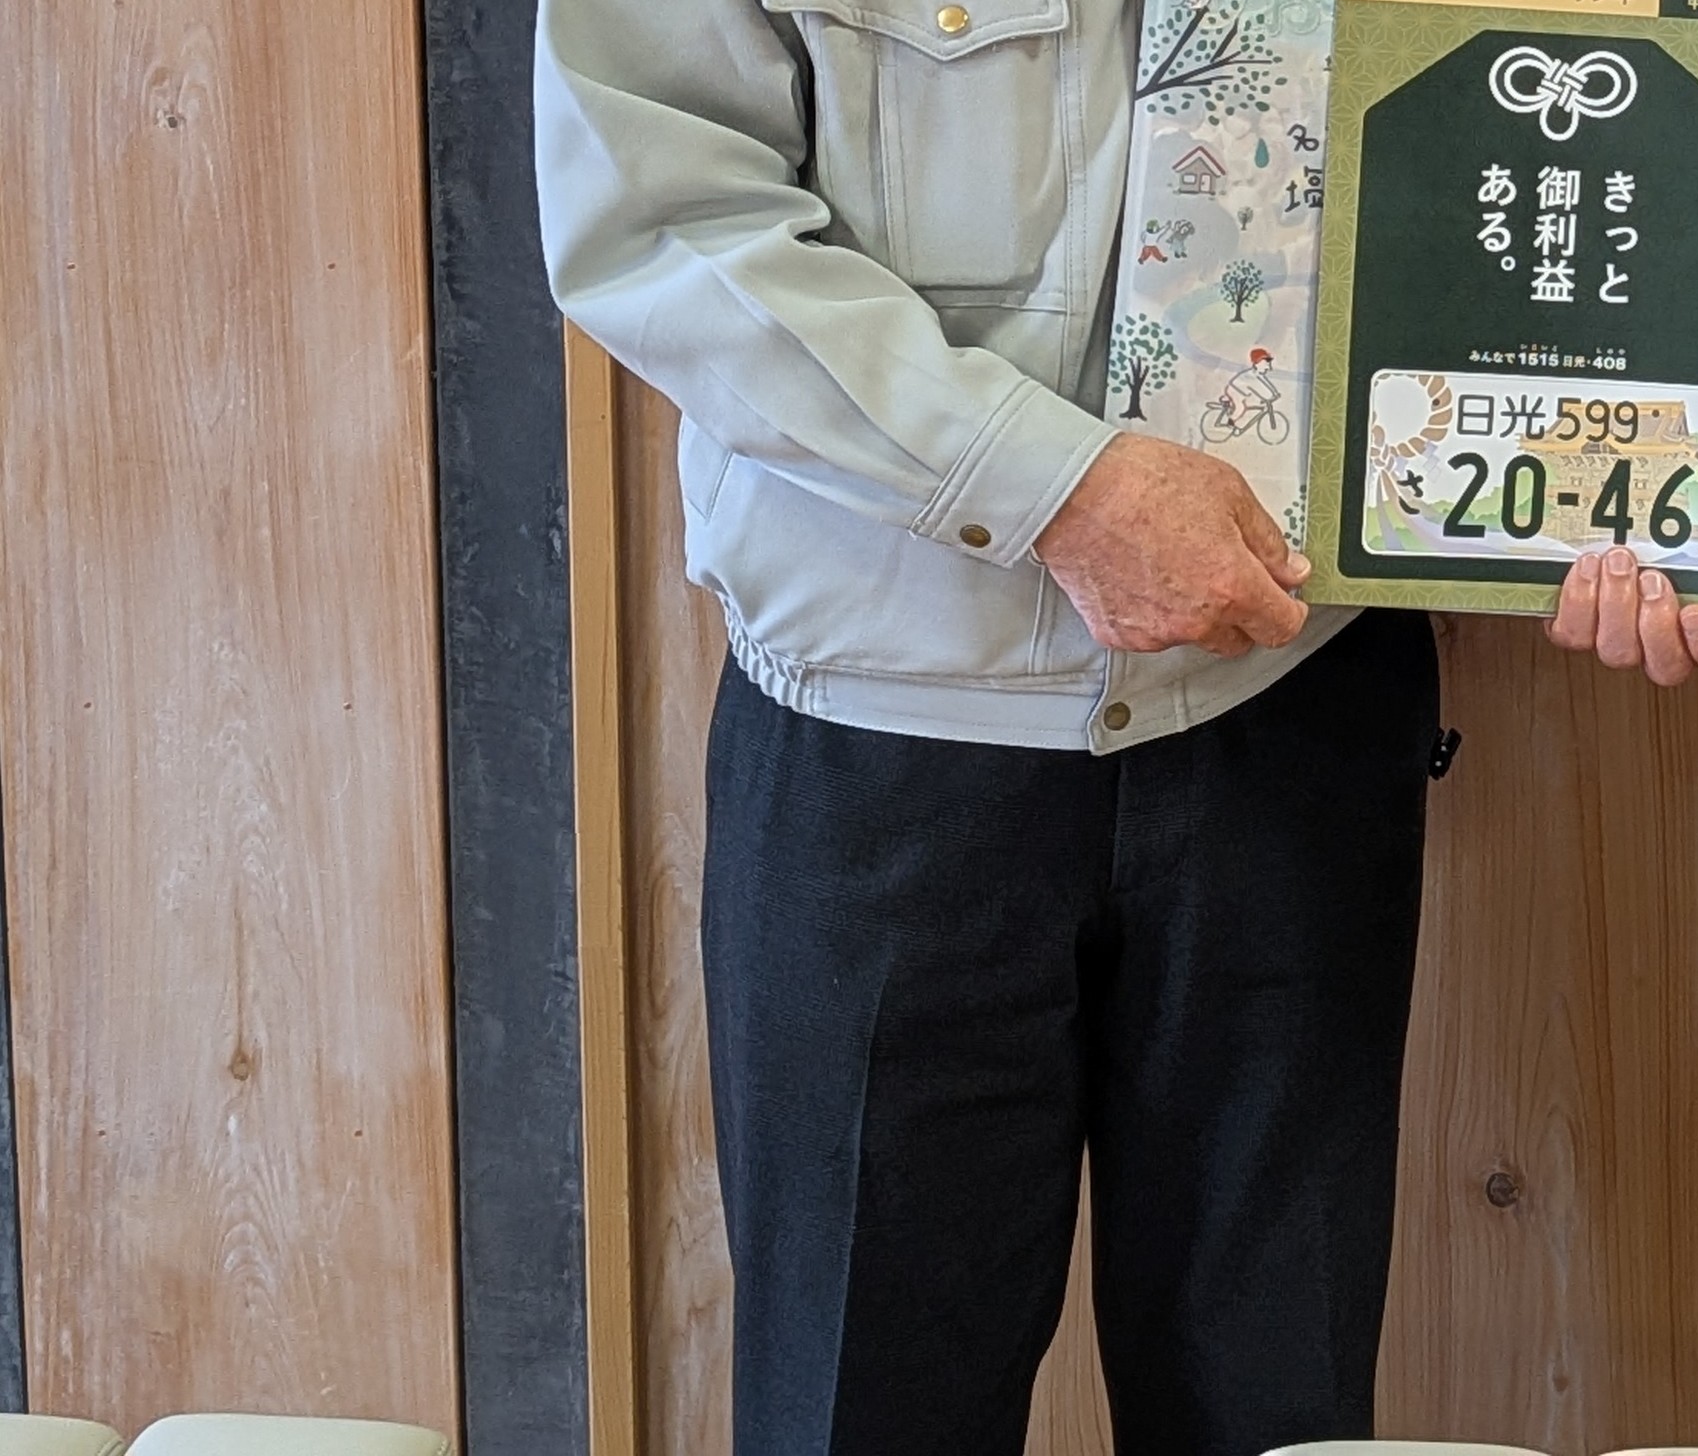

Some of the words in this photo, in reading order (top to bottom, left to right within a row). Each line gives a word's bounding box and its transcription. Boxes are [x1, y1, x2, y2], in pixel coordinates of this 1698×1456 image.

[1476, 163, 1518, 272] ある。
[1530, 165, 1582, 302] 御利益
[1599, 170, 1639, 303] きっと
[1398, 469, 1425, 515] さ
[1442, 451, 1696, 550] 20-46
